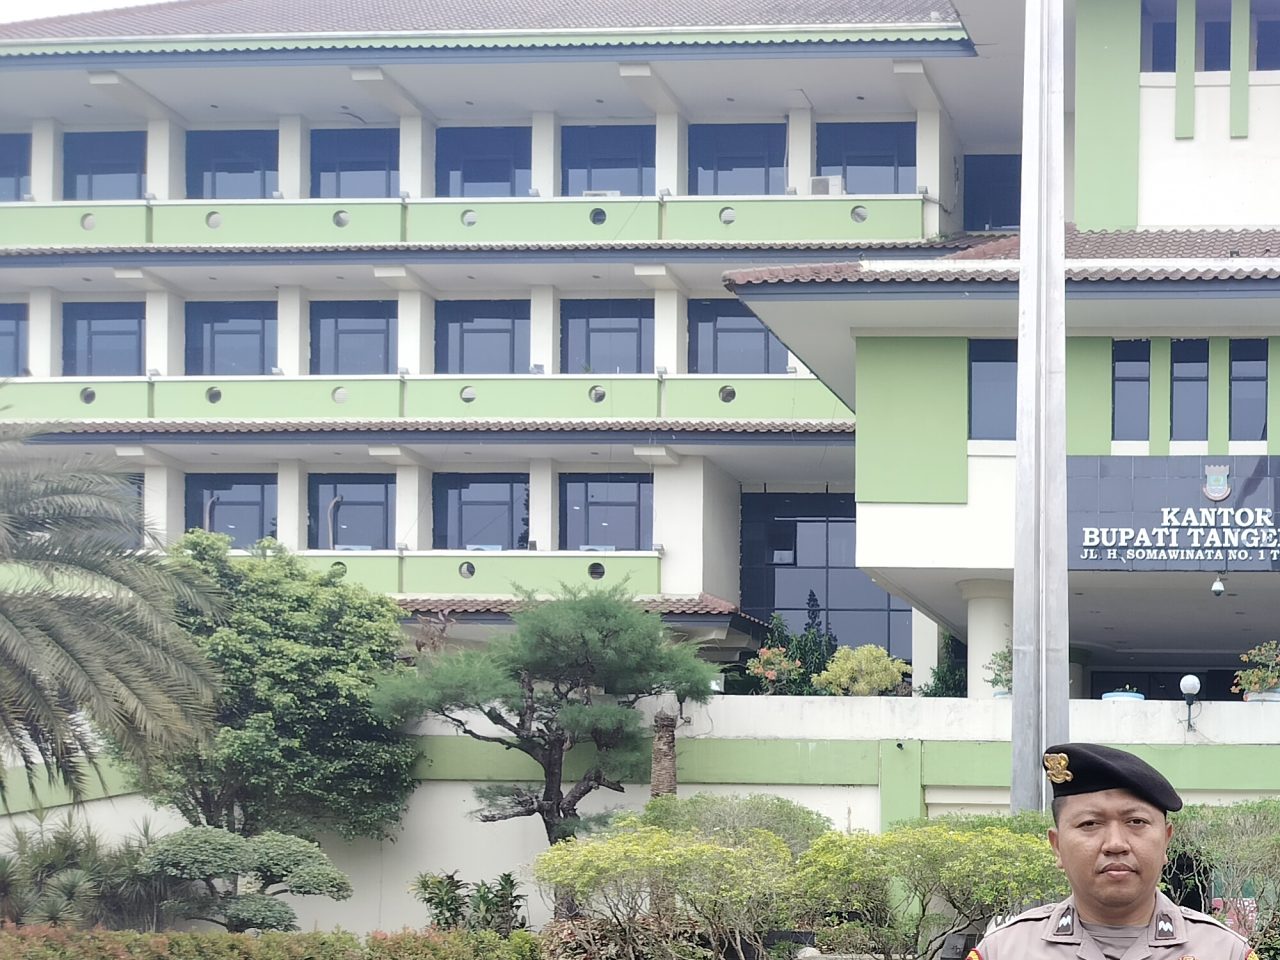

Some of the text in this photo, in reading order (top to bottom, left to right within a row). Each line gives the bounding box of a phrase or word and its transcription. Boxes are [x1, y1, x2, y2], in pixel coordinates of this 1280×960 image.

[1160, 507, 1275, 527] KANTOR
[1082, 527, 1179, 547] BUPATI
[1126, 548, 1224, 560] SOMAWINATA
[1227, 549, 1253, 560] NO.
[1258, 549, 1265, 560] 1
